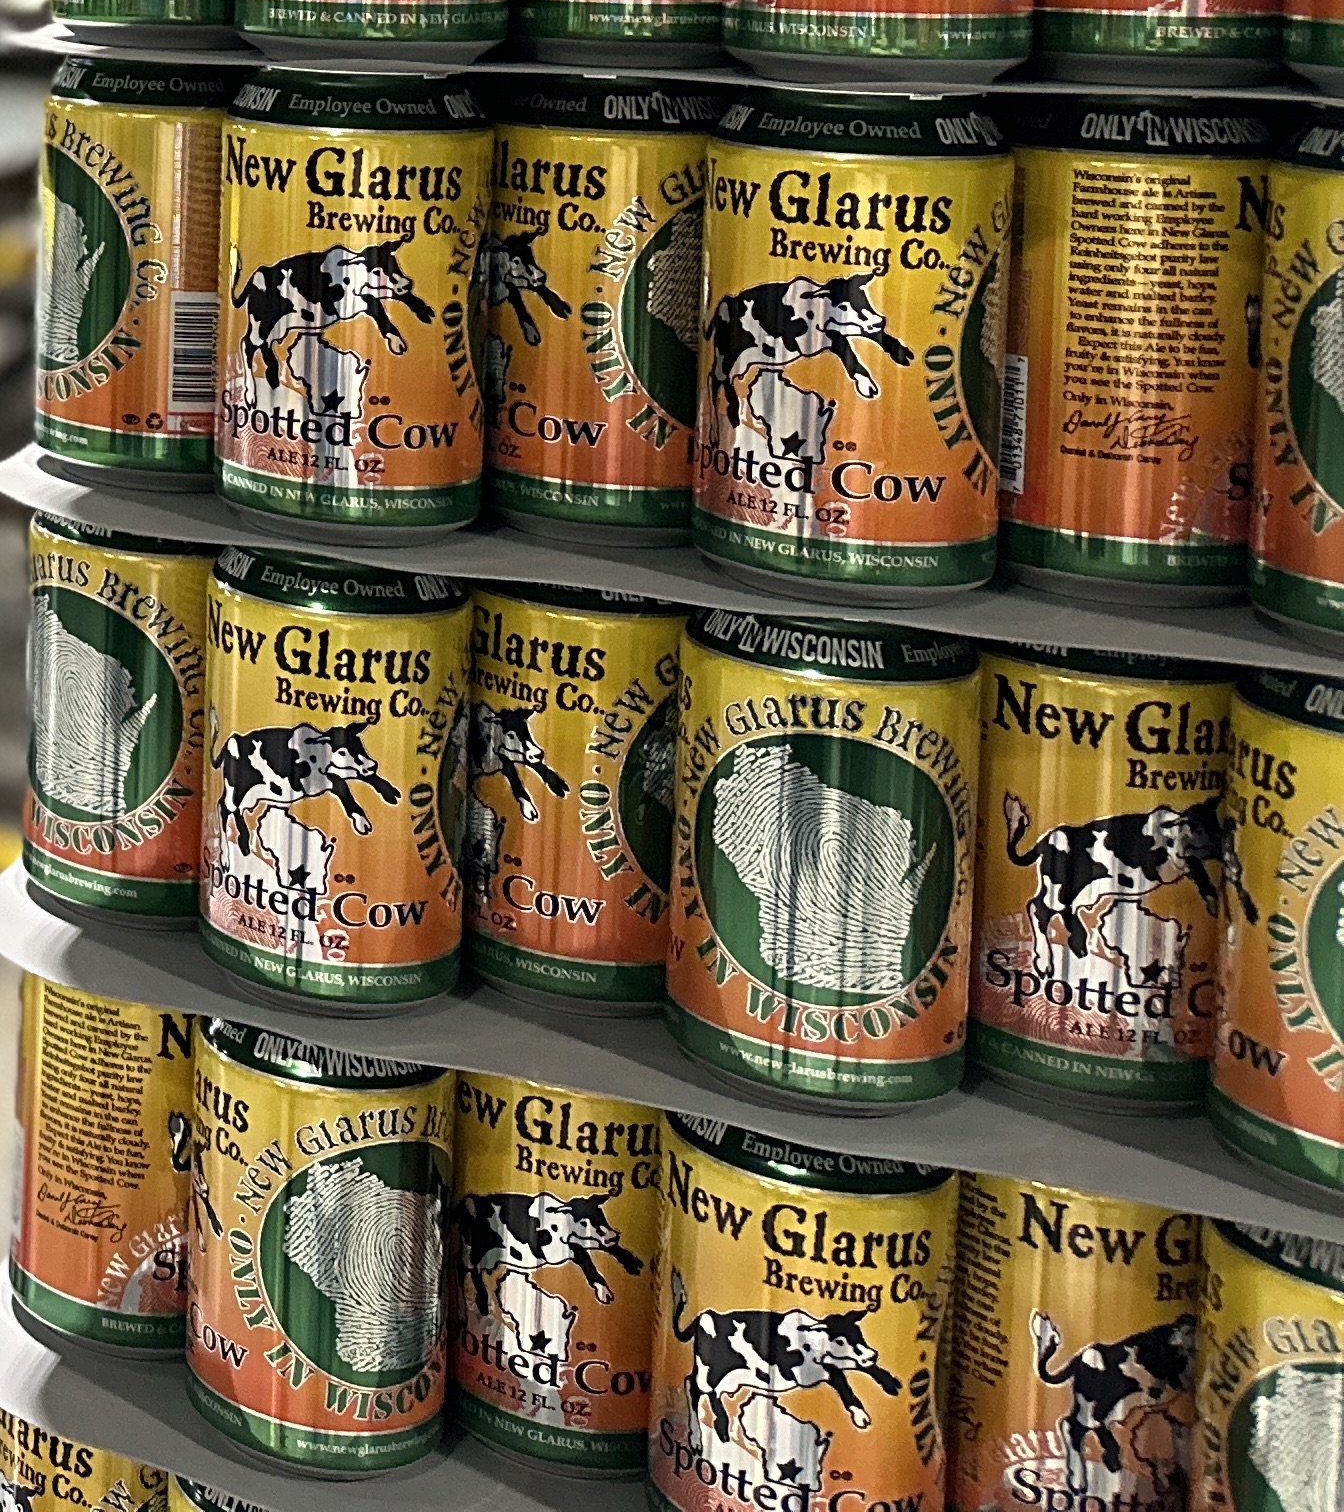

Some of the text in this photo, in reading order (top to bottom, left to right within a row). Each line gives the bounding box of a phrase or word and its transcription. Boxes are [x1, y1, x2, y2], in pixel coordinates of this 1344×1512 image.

[288, 93, 478, 120] Employee Owned ONLY
[603, 94, 651, 120] ONLY
[757, 113, 922, 140] Employee Owned
[1080, 113, 1136, 140] ONLY
[59, 121, 162, 248] Brewing
[224, 133, 462, 203] New Glarus
[305, 202, 416, 242] Brewing
[768, 169, 952, 234] Glarus
[588, 195, 658, 281] New
[769, 228, 890, 277] Brewing
[580, 299, 677, 450] ONLY IN
[220, 389, 459, 451] Spotted Cow
[266, 446, 299, 465] ALE
[302, 452, 320, 468] 12
[830, 459, 945, 504] Cow
[269, 483, 284, 498] IN
[261, 564, 453, 602] Employee Owned ONLY
[95, 568, 205, 700] Brewing
[208, 595, 432, 686] New Glarus
[703, 609, 884, 669] ONLY WISCONSIN
[275, 676, 381, 726] Brewing
[585, 678, 657, 761] New
[724, 693, 868, 738] Glarus
[992, 674, 1115, 749] New
[29, 782, 195, 857] WISCONSIN
[332, 892, 428, 930] Cow
[744, 941, 960, 1045] WISCONSIN
[985, 952, 1172, 1020] Spotted
[238, 1104, 417, 1218] New Glarus
[515, 1143, 624, 1196] Brewing
[741, 1131, 904, 1175] Employee Owned
[668, 1149, 932, 1269] New Glarus
[1017, 1191, 1146, 1266] New
[229, 1229, 315, 1390] ONLY IN
[763, 1255, 884, 1312] Brewing
[475, 1372, 508, 1397] ALE
[509, 1382, 528, 1403] 12
